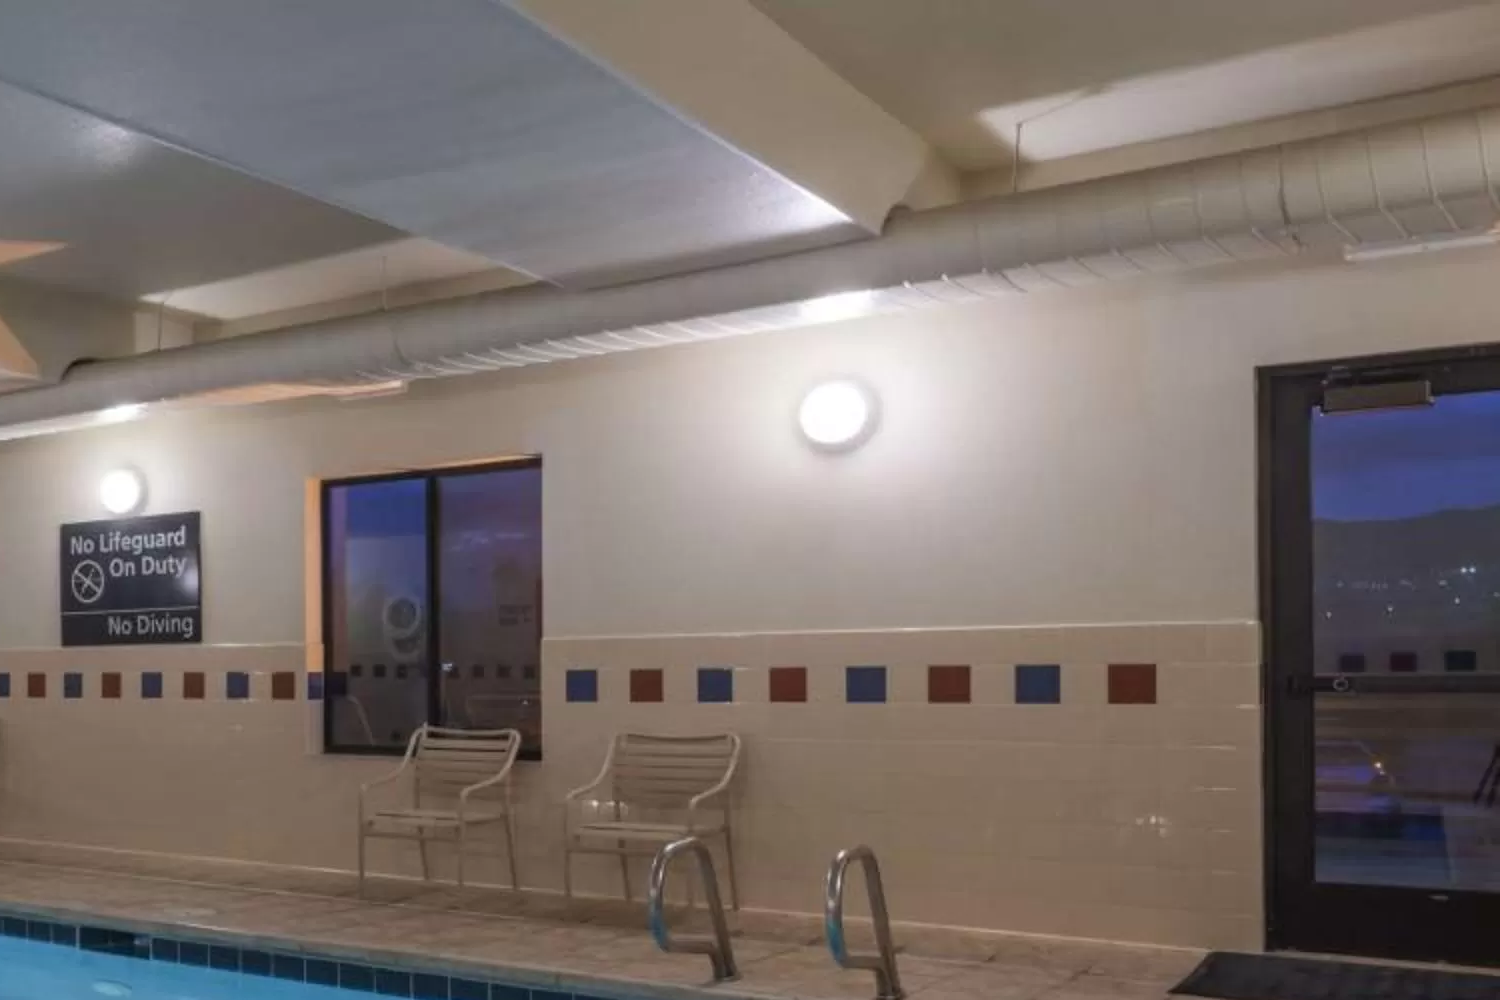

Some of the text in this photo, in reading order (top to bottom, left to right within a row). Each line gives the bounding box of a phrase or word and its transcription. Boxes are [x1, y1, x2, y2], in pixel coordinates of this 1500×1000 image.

[70, 525, 186, 555] No Lifeguard
[109, 555, 187, 578] On Duty
[107, 612, 193, 638] No Diving
